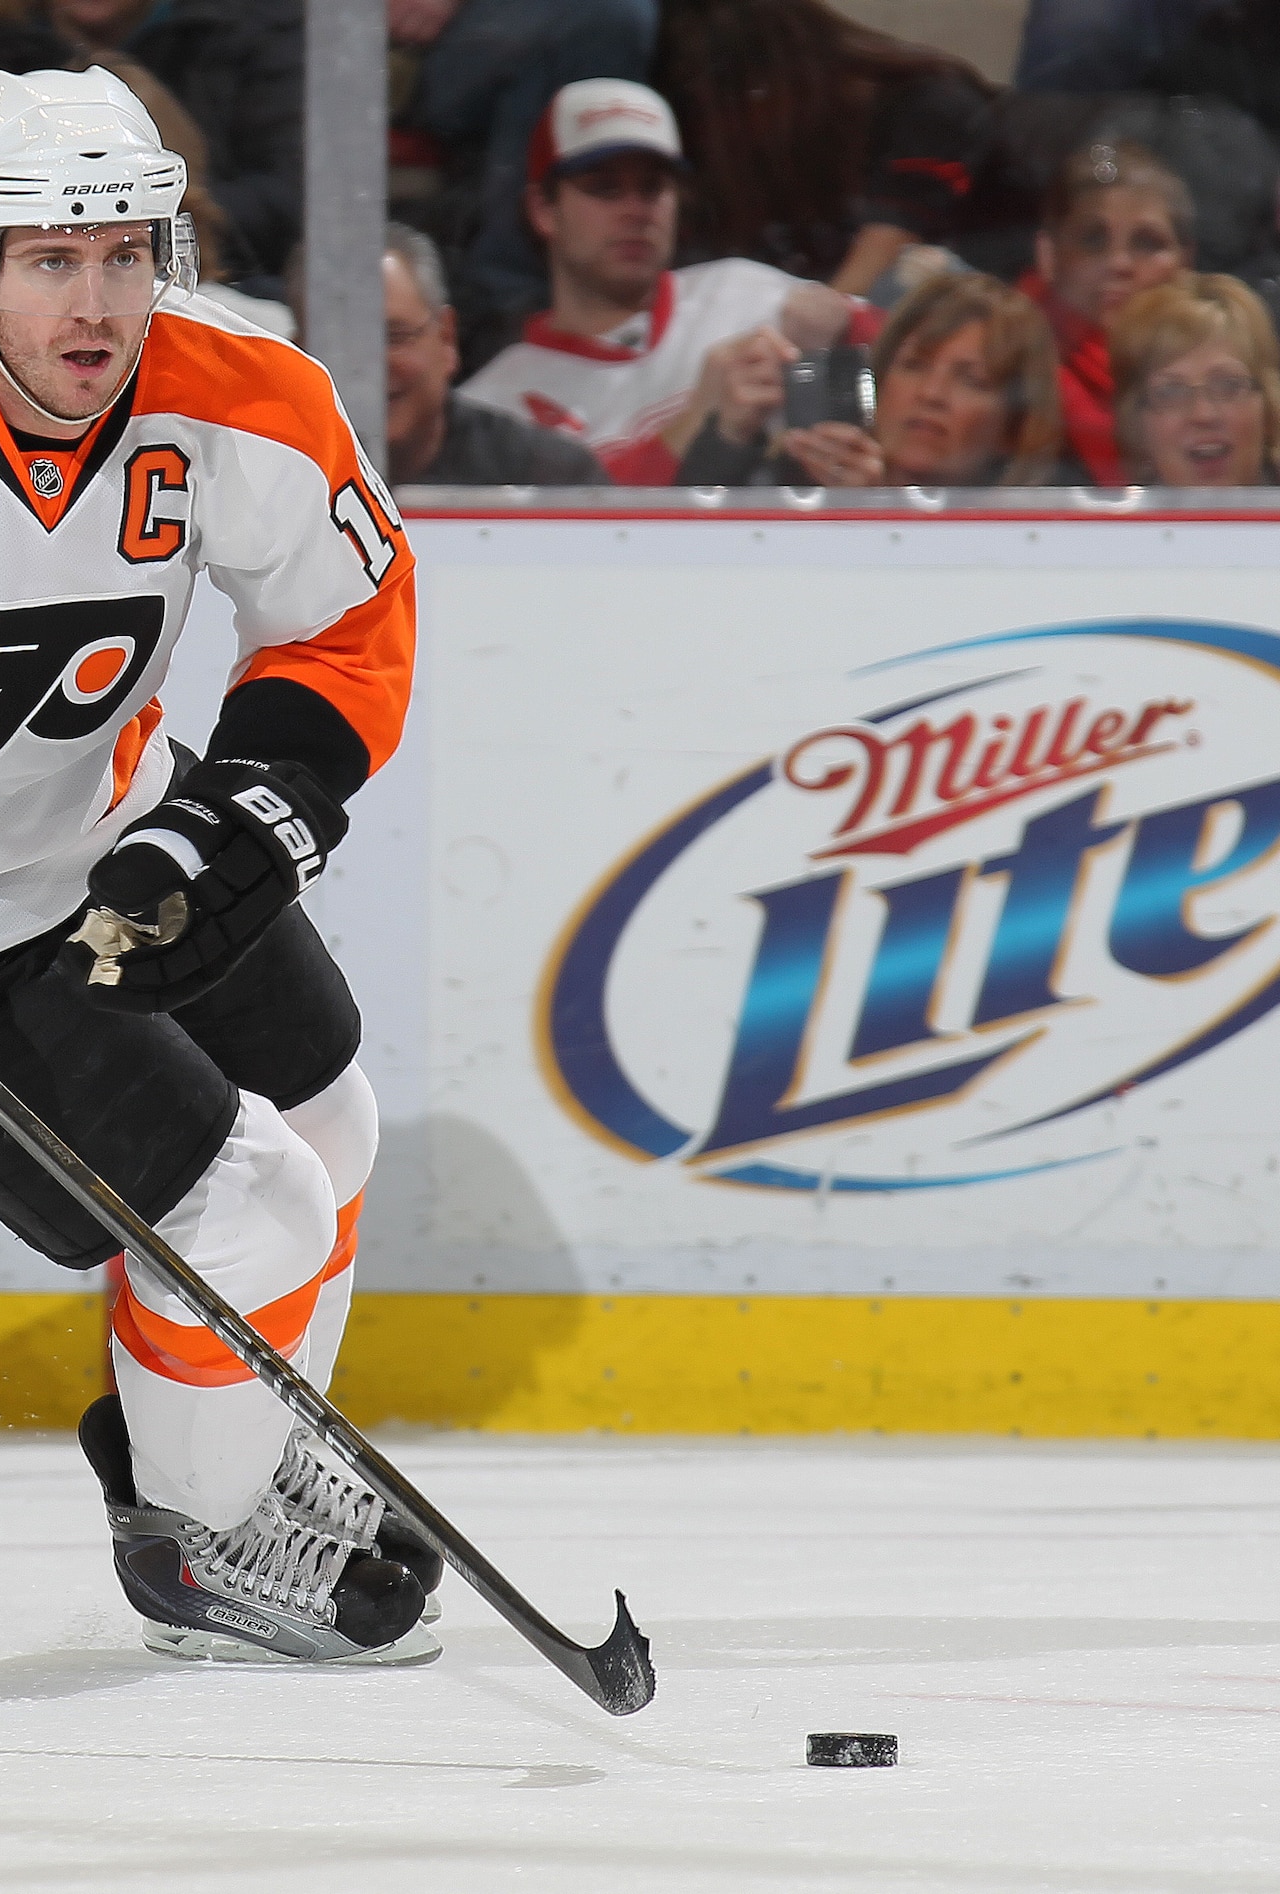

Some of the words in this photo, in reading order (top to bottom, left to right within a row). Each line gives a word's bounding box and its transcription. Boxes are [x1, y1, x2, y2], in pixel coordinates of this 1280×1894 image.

[62, 182, 134, 196] BAUER
[37, 468, 56, 488] NHL
[117, 444, 190, 563] C
[784, 696, 1196, 840] Miller
[683, 778, 1280, 1166] Lite
[213, 1609, 272, 1635] BAUER
